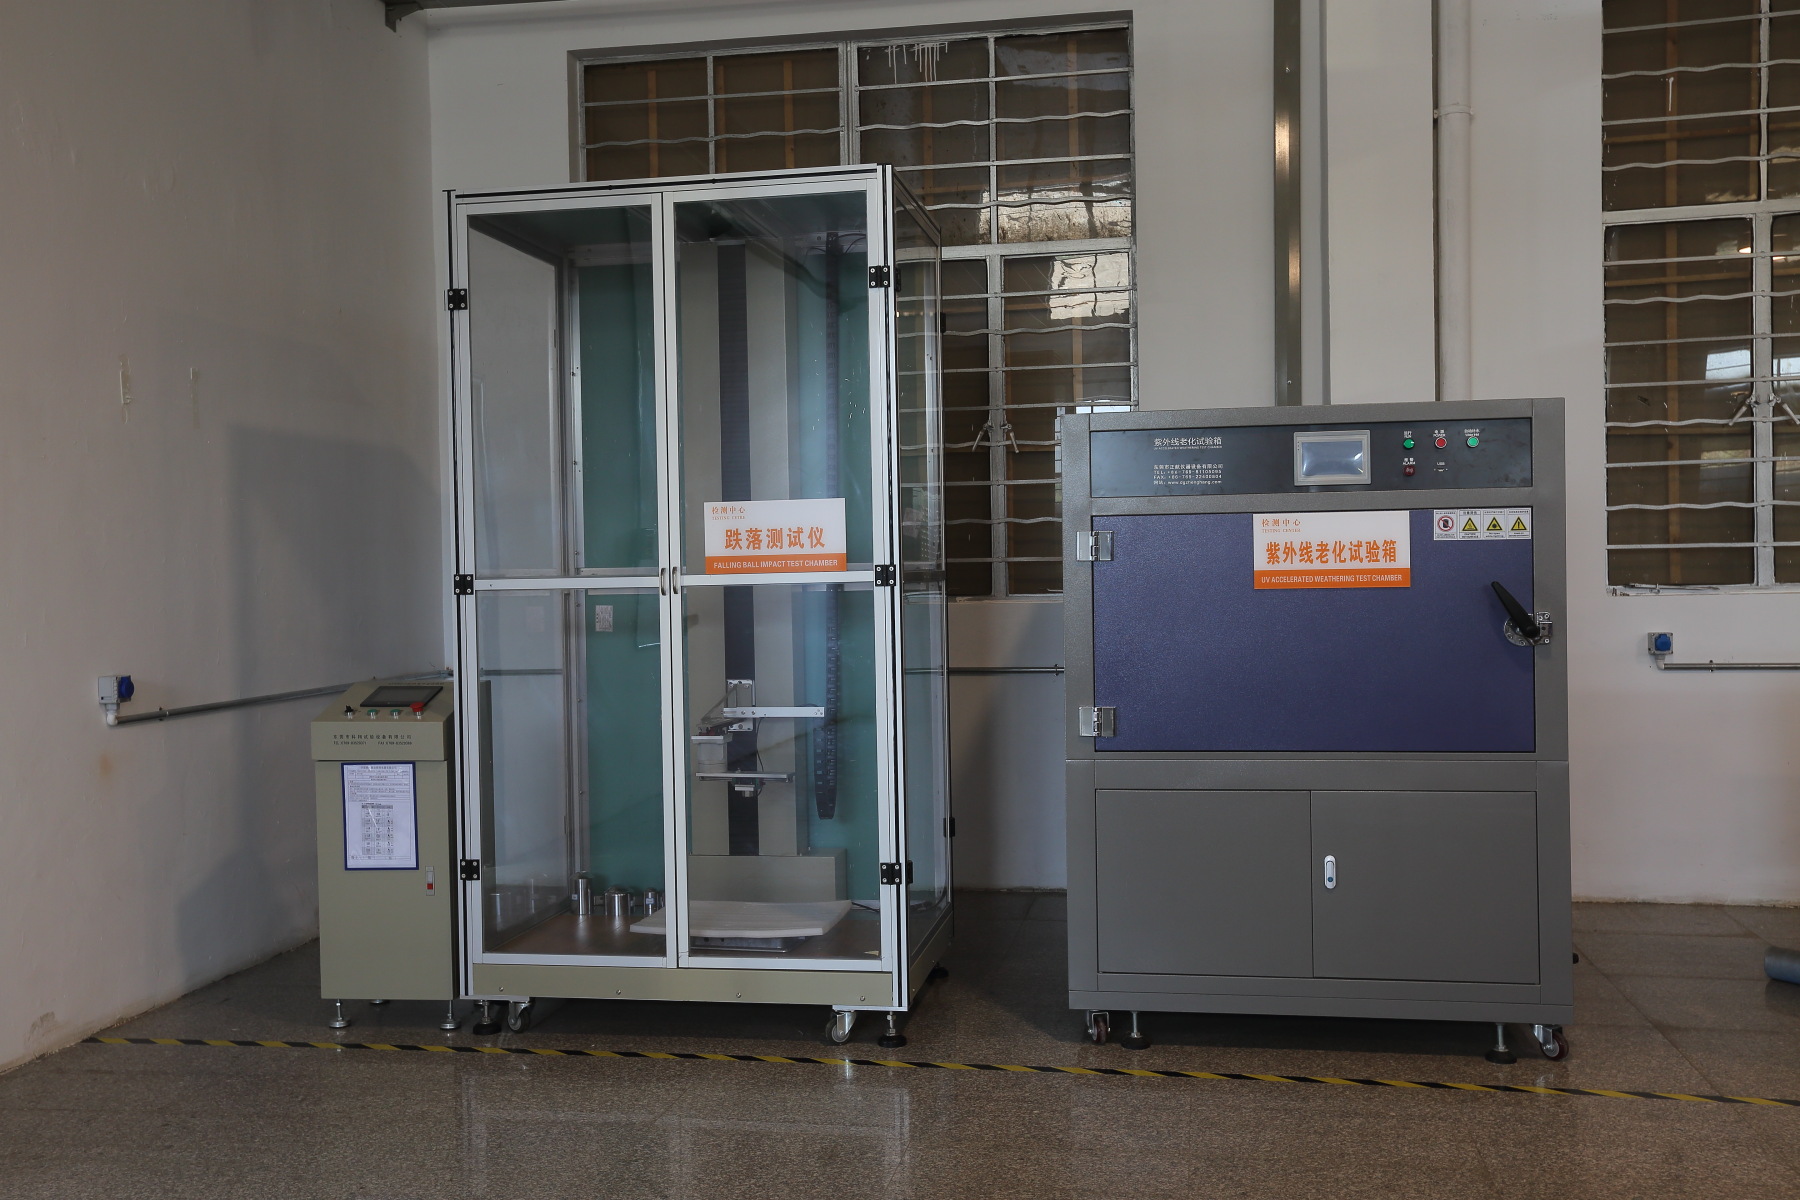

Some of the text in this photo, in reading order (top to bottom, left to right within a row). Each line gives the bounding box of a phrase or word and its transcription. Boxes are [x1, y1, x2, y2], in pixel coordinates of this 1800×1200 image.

[1154, 436, 1222, 446] 紫外线老化试验箱
[712, 506, 746, 515] 检测中心
[1262, 518, 1301, 527] 检测中心
[724, 526, 826, 550] 跌落测试仪
[1266, 540, 1397, 565] 紫外线老化试验箱
